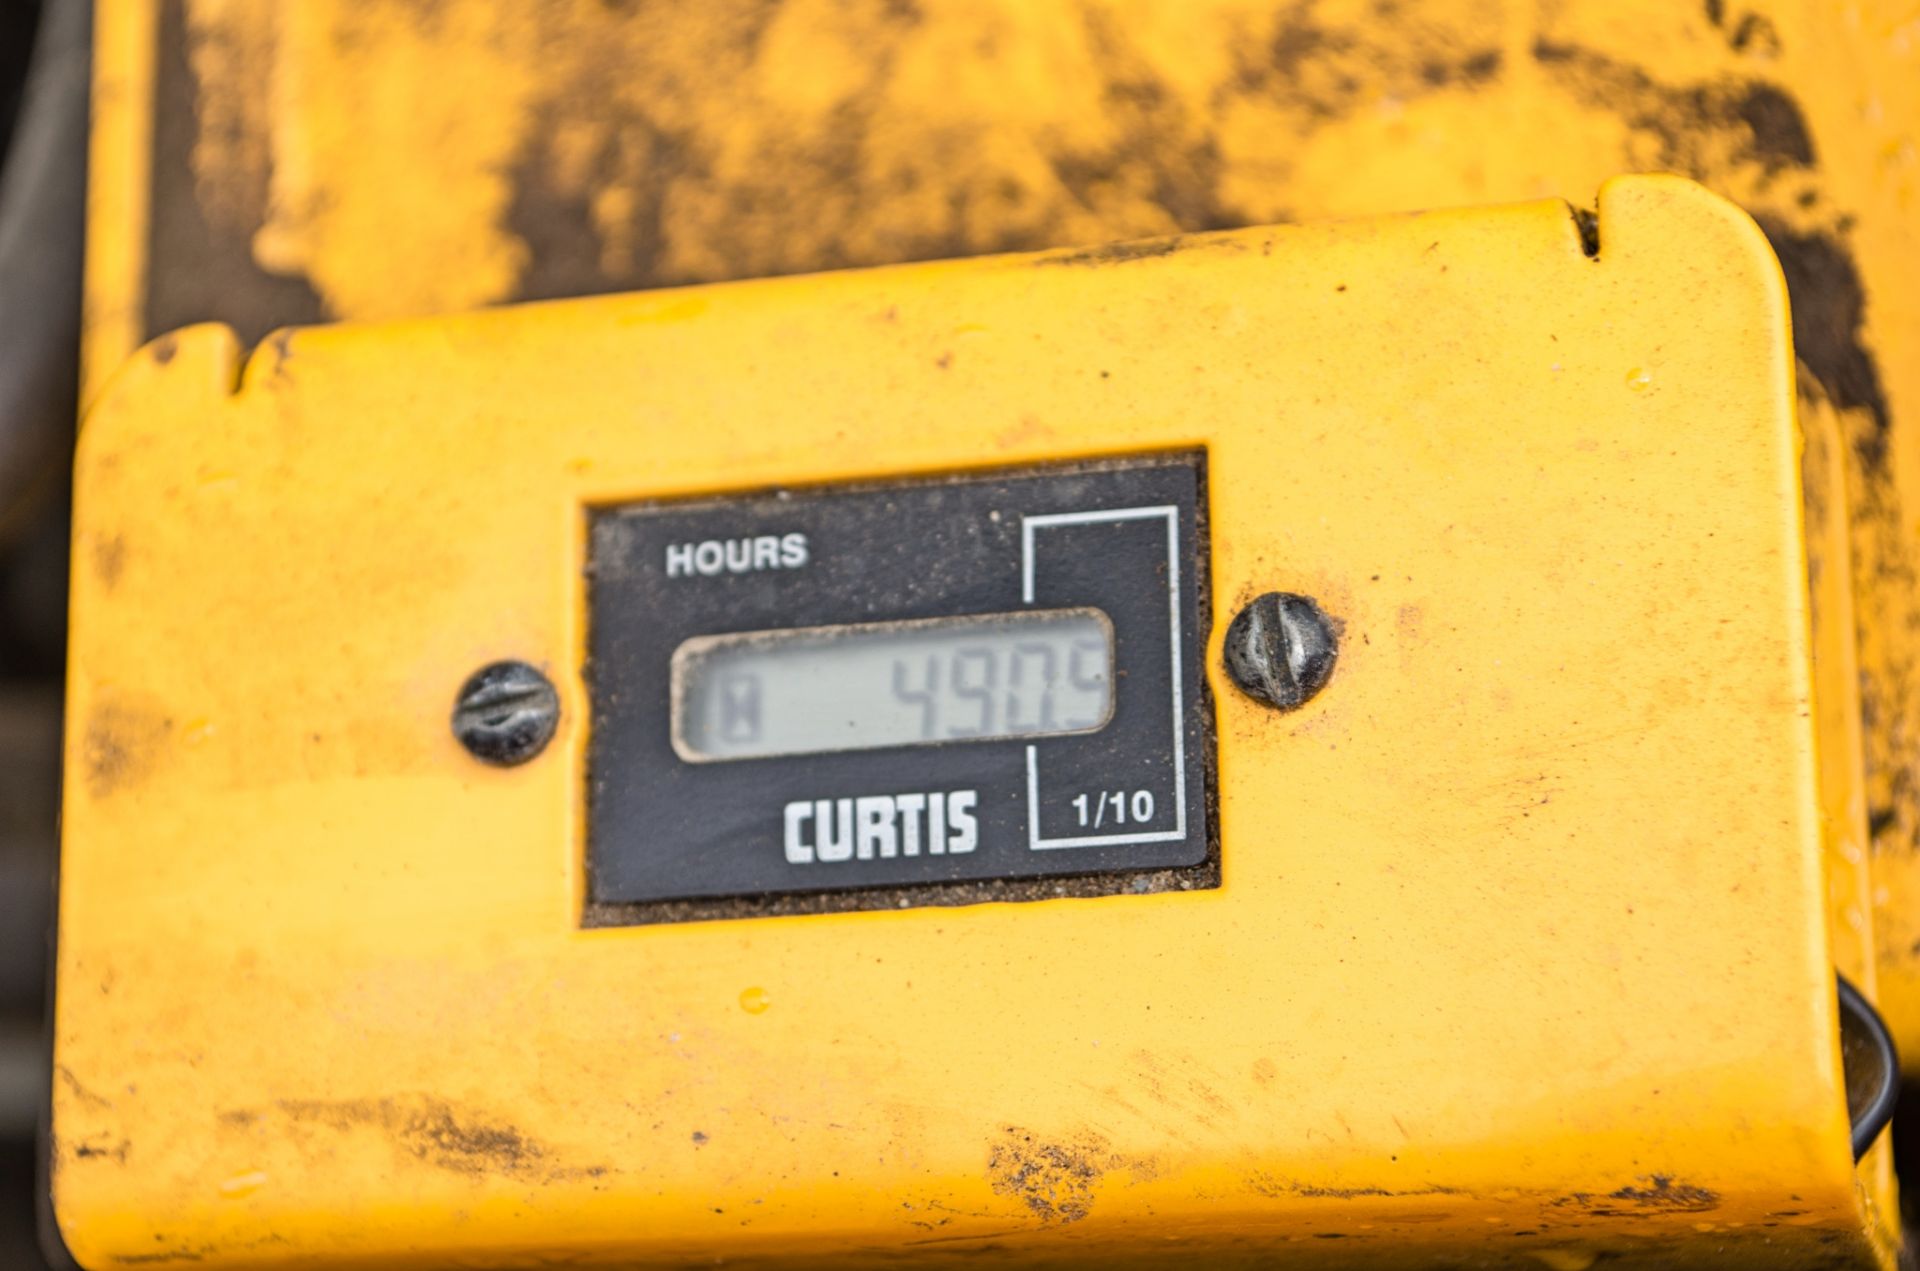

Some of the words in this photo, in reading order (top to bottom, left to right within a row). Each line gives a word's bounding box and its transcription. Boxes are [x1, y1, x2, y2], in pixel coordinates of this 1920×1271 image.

[665, 532, 809, 578] HOURS
[782, 789, 979, 864] CURTIS
[1071, 789, 1155, 829] 1/10
